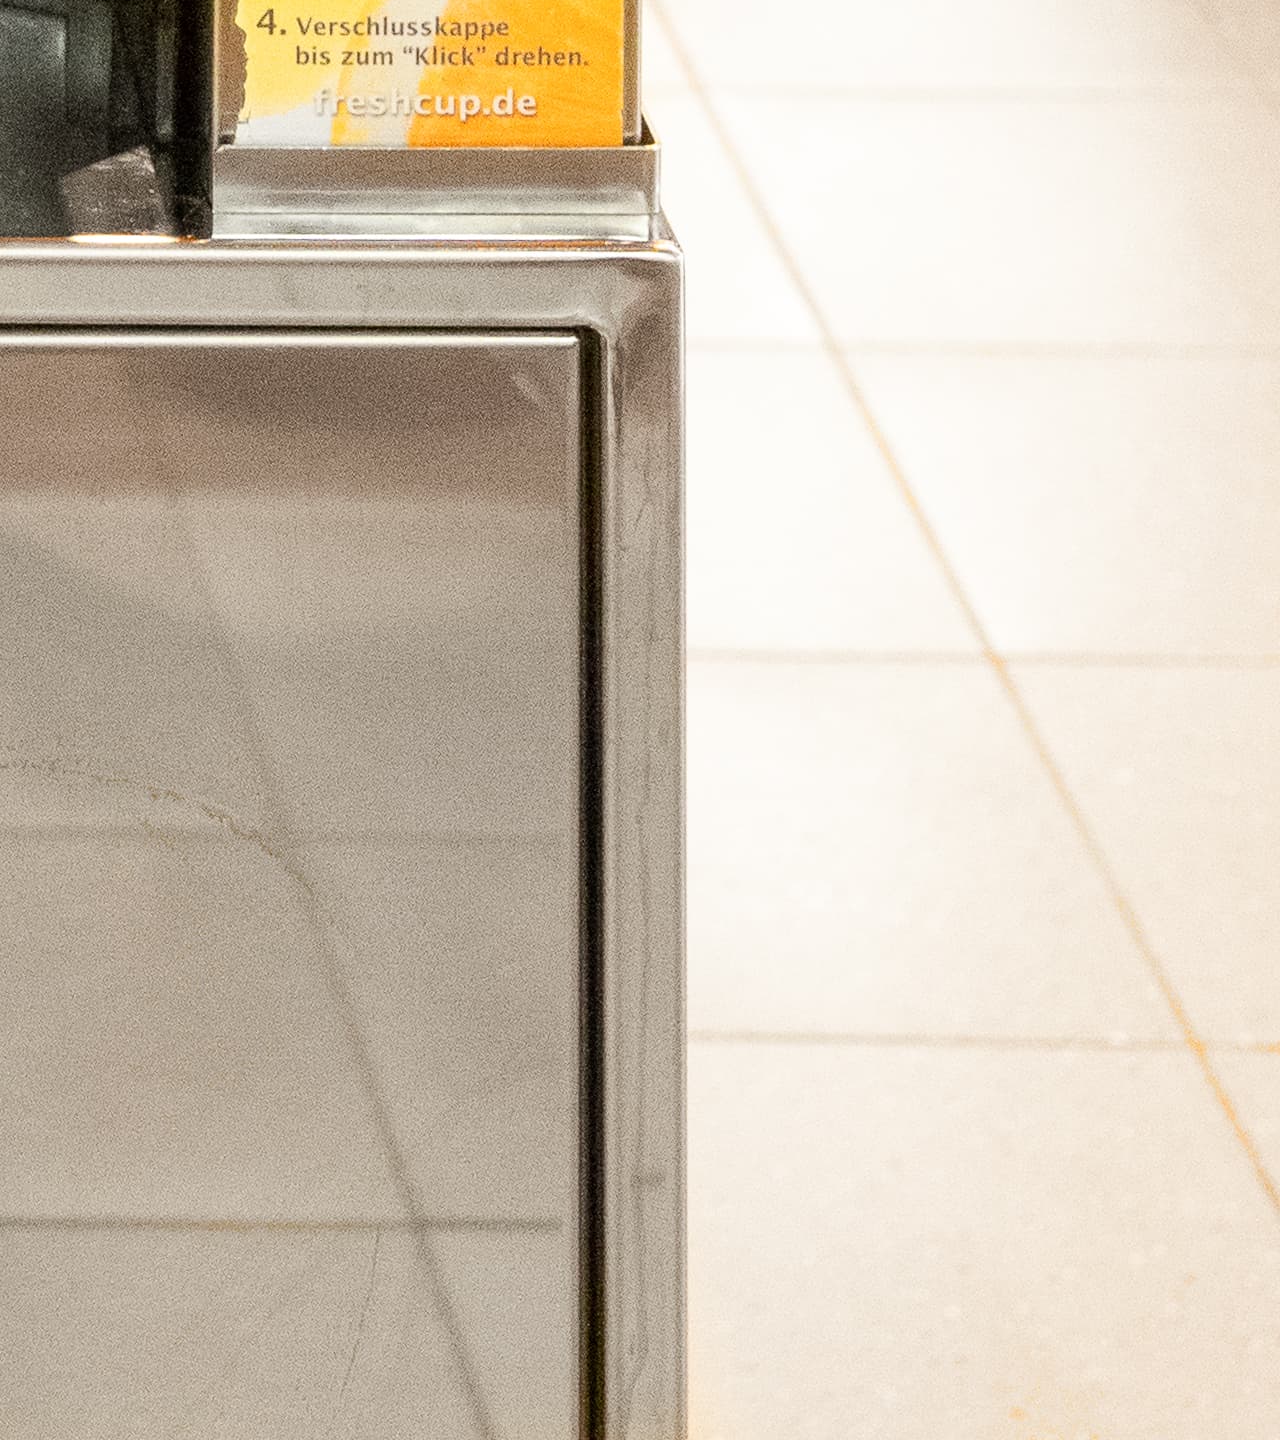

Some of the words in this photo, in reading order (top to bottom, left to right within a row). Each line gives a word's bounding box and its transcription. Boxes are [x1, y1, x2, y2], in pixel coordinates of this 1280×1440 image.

[256, 9, 286, 36] 4.
[296, 17, 509, 41] Verschlusskappe
[296, 46, 330, 66] bis
[341, 50, 393, 66] zum
[495, 47, 588, 67] drehen.
[314, 88, 537, 121] freshcup.de
